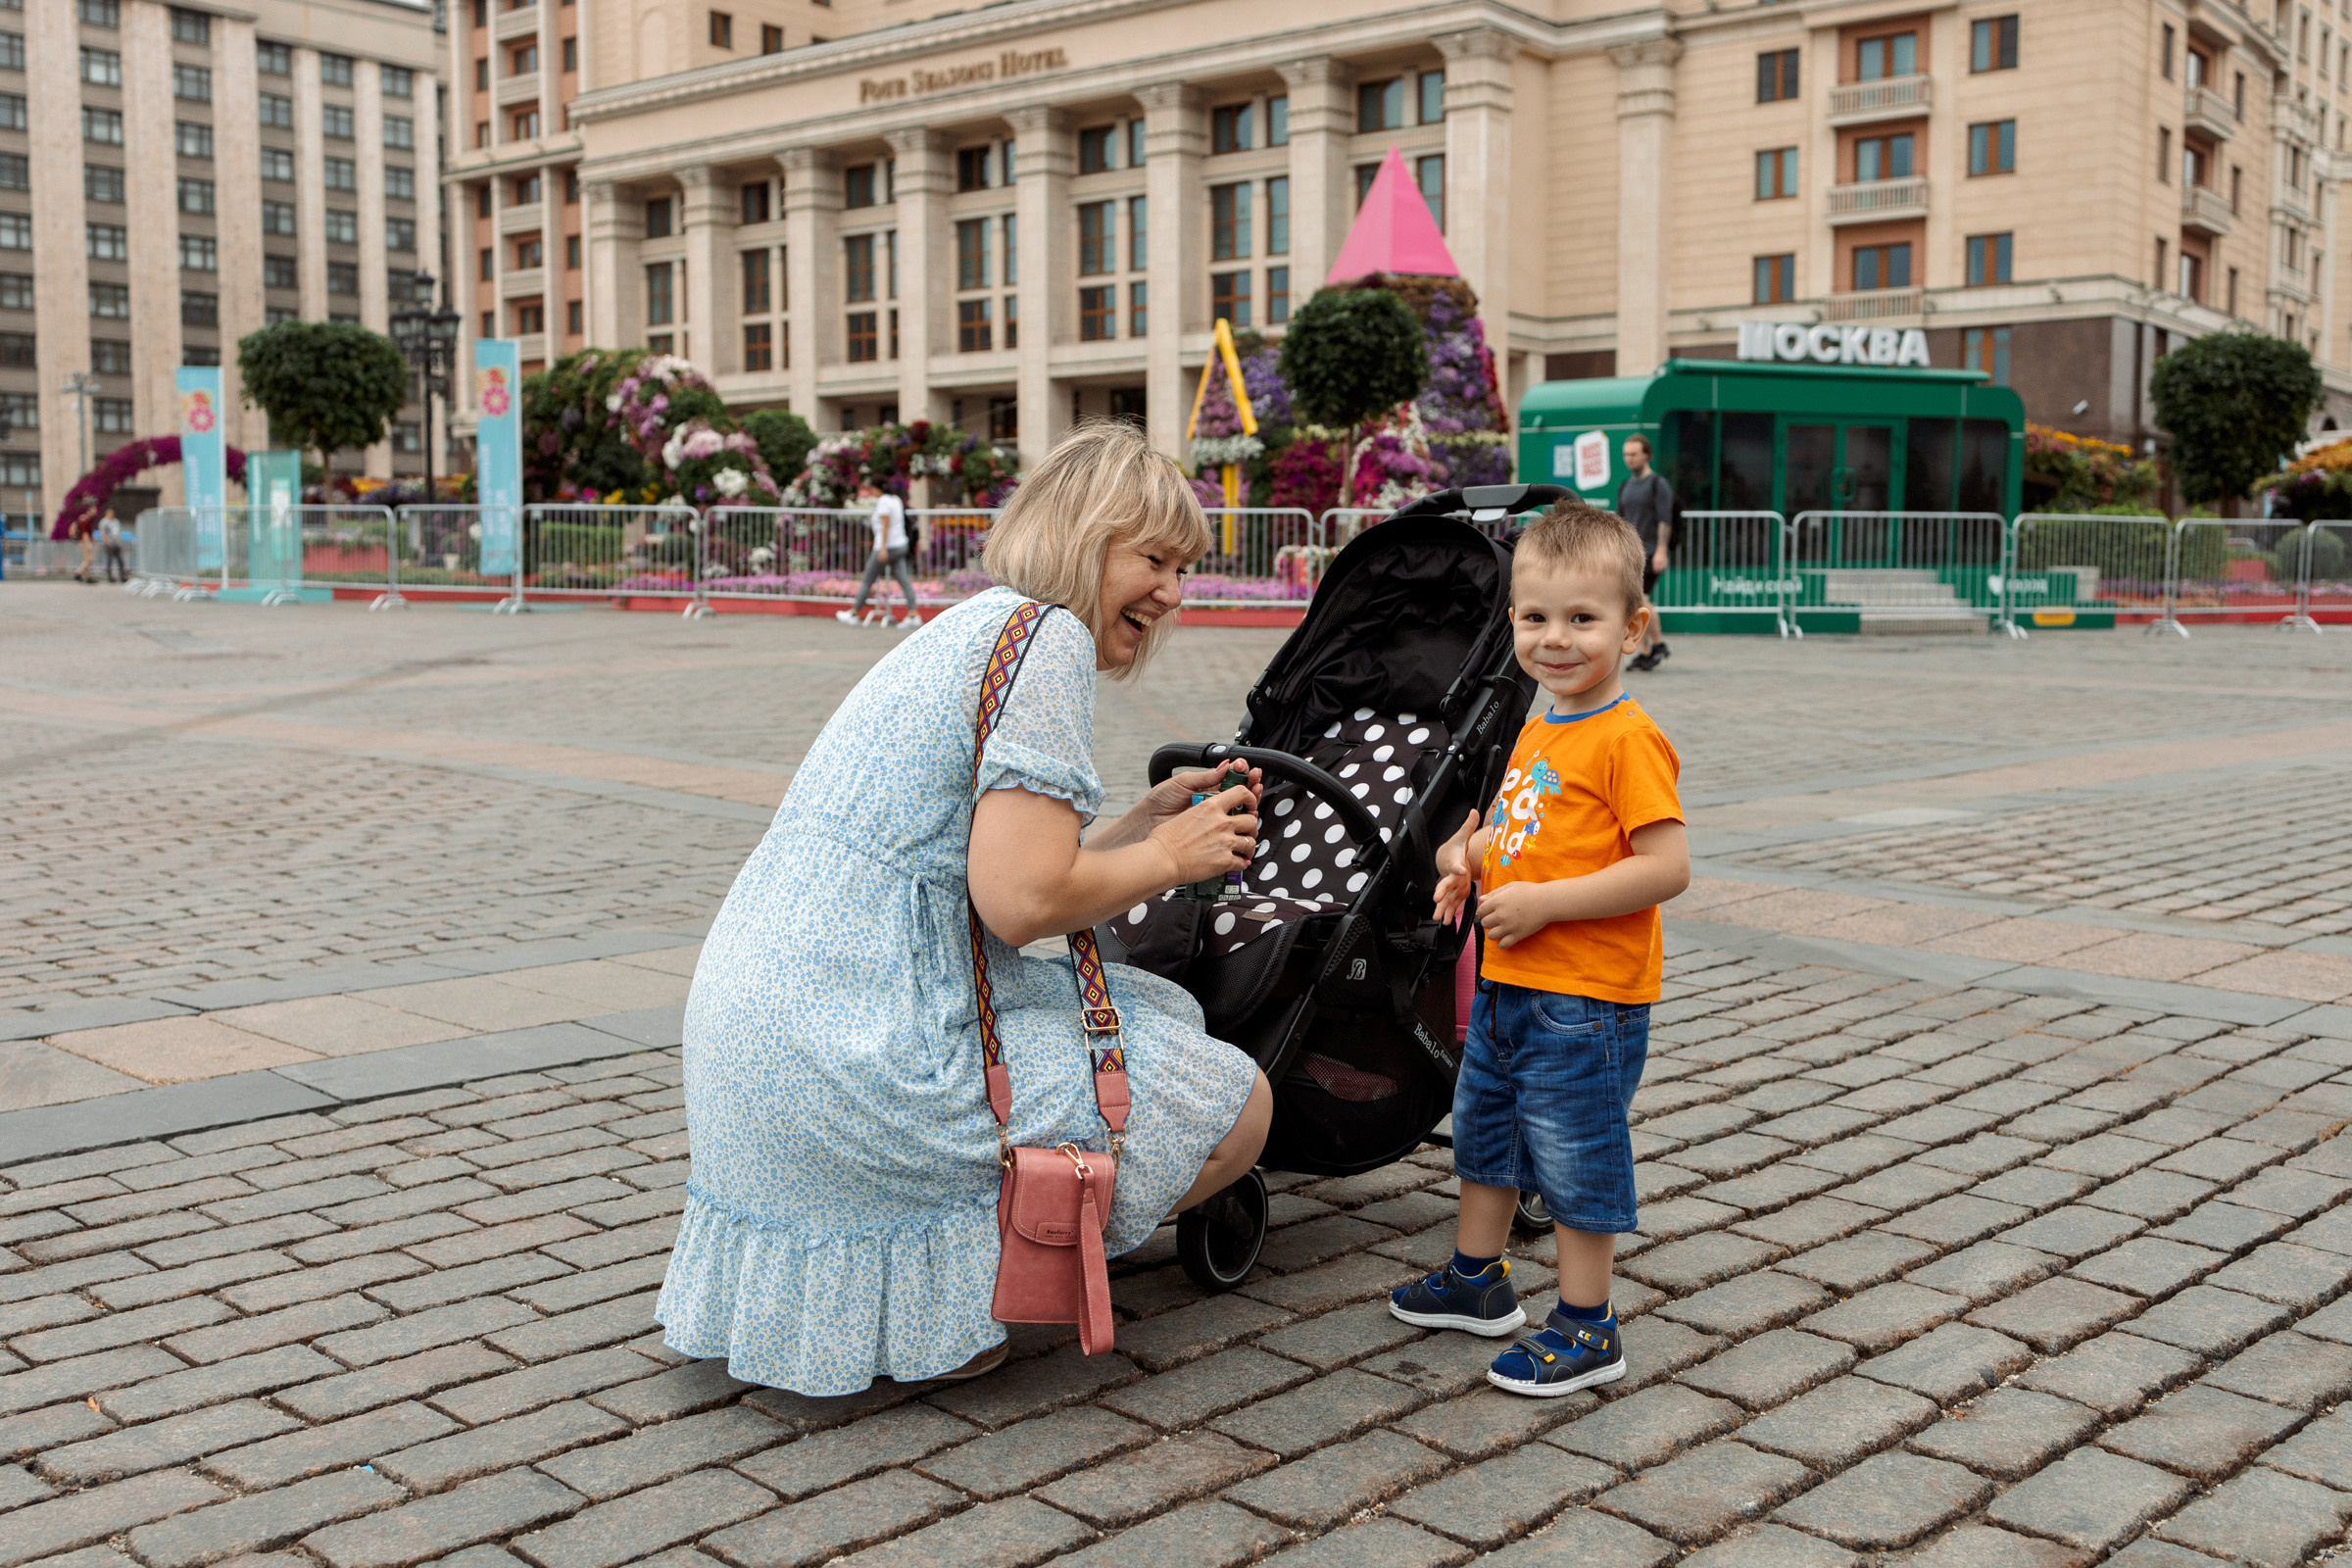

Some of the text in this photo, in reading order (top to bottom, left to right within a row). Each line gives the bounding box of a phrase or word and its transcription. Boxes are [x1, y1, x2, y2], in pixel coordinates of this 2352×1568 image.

[1737, 320, 1931, 367] МОСКВА
[1476, 701, 1499, 735] Babalo
[1500, 767, 1540, 820] ea
[1413, 1022, 1440, 1058] Babalo
